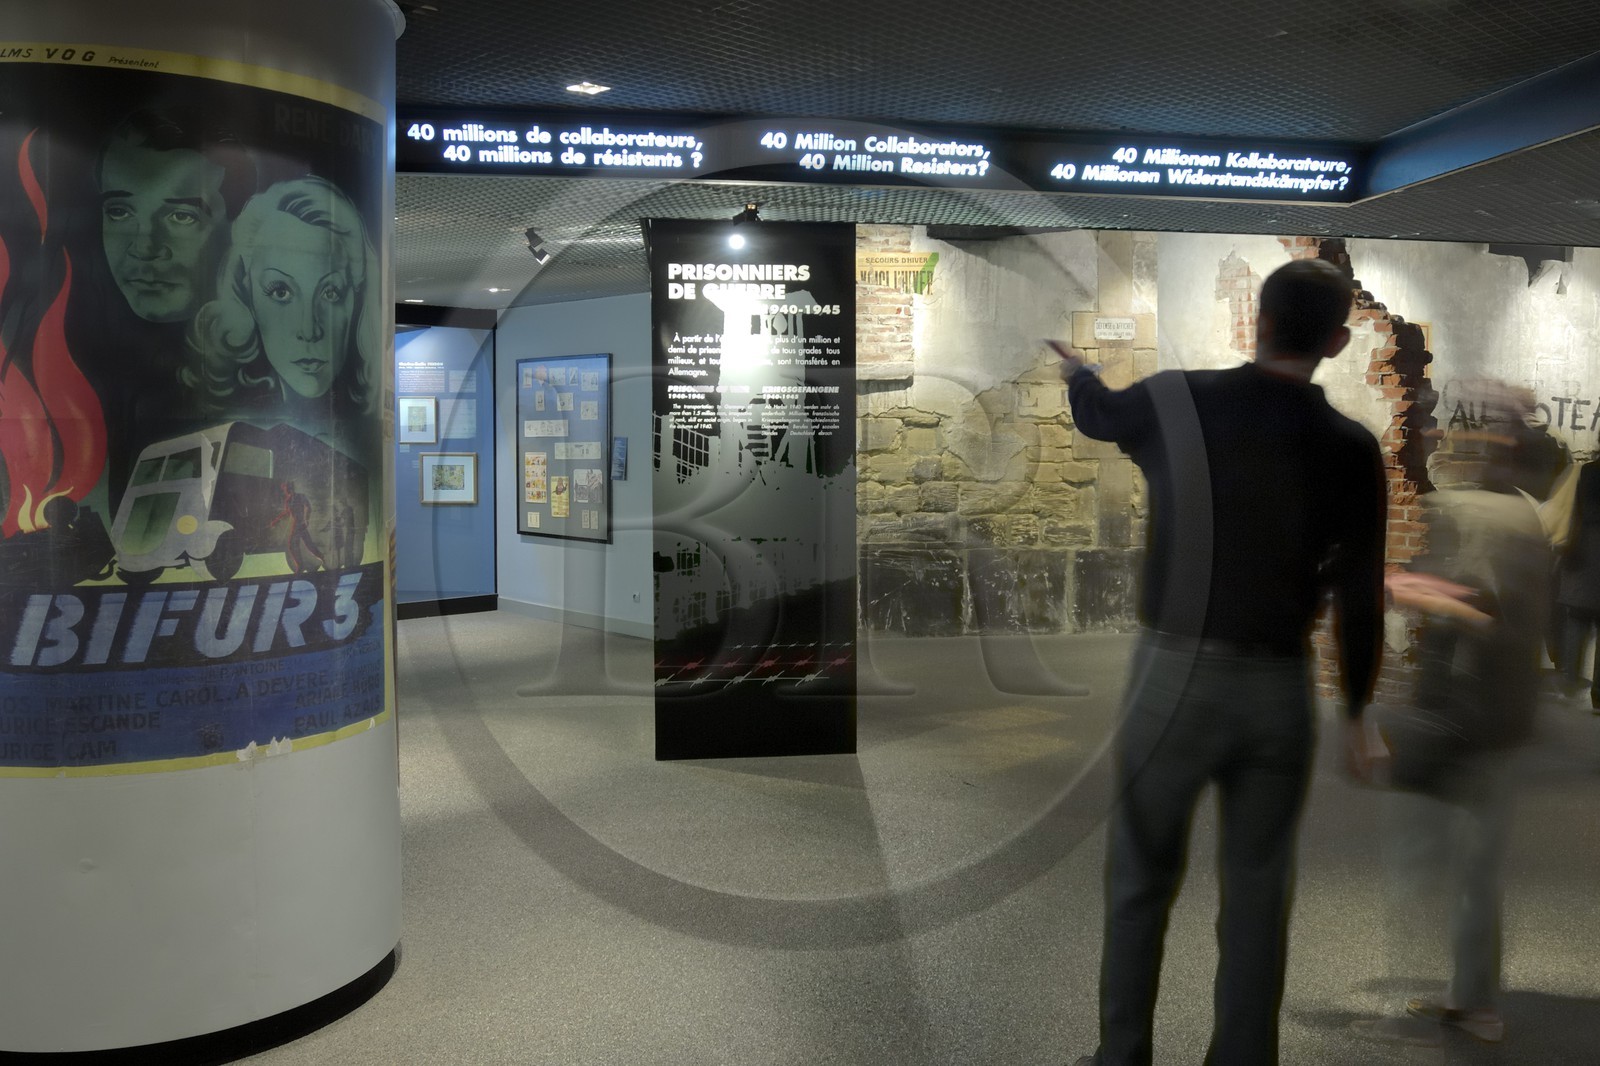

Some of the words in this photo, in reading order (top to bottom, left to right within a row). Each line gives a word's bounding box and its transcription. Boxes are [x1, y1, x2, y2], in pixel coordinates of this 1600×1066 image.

[407, 123, 435, 140] 40
[443, 124, 518, 142] millions
[525, 125, 551, 143] de
[559, 127, 703, 151] collaborateurs,
[760, 132, 787, 149] 40
[795, 133, 857, 151] Million
[864, 136, 990, 159] Collaborators,
[443, 145, 471, 161] 40
[478, 145, 553, 163] millions
[560, 147, 586, 164] de
[593, 148, 682, 167] résistants
[690, 151, 703, 168] ?
[799, 153, 825, 169] 40
[833, 154, 894, 172] Million
[901, 156, 989, 177] Resisters?
[1112, 147, 1138, 163] 40
[1143, 148, 1221, 167] Millionen
[1226, 152, 1352, 174] Kollaborateure,
[1050, 163, 1076, 180] 40
[1081, 164, 1160, 183] Millionen
[1167, 168, 1349, 193] Widerstandskämpfer?
[668, 263, 811, 281] PRISONNIERS
[668, 283, 696, 300] DE
[673, 332, 681, 342] À
[682, 334, 702, 344] partir
[703, 333, 714, 343] de
[775, 335, 789, 344] plus
[790, 335, 807, 344] d'un
[809, 335, 832, 344] million
[833, 336, 841, 344] et
[667, 344, 686, 353] demi
[687, 344, 697, 354] de
[770, 346, 780, 355] de
[798, 346, 822, 356] grades
[826, 347, 841, 355] tous
[667, 355, 695, 365] milieux,
[698, 357, 706, 365] et
[777, 358, 792, 366] sont
[795, 356, 828, 366] transférés
[667, 366, 708, 378] Allemagne.
[762, 385, 840, 393] KRIEGSGEFANGENE
[10, 580, 317, 666] BIFUR
